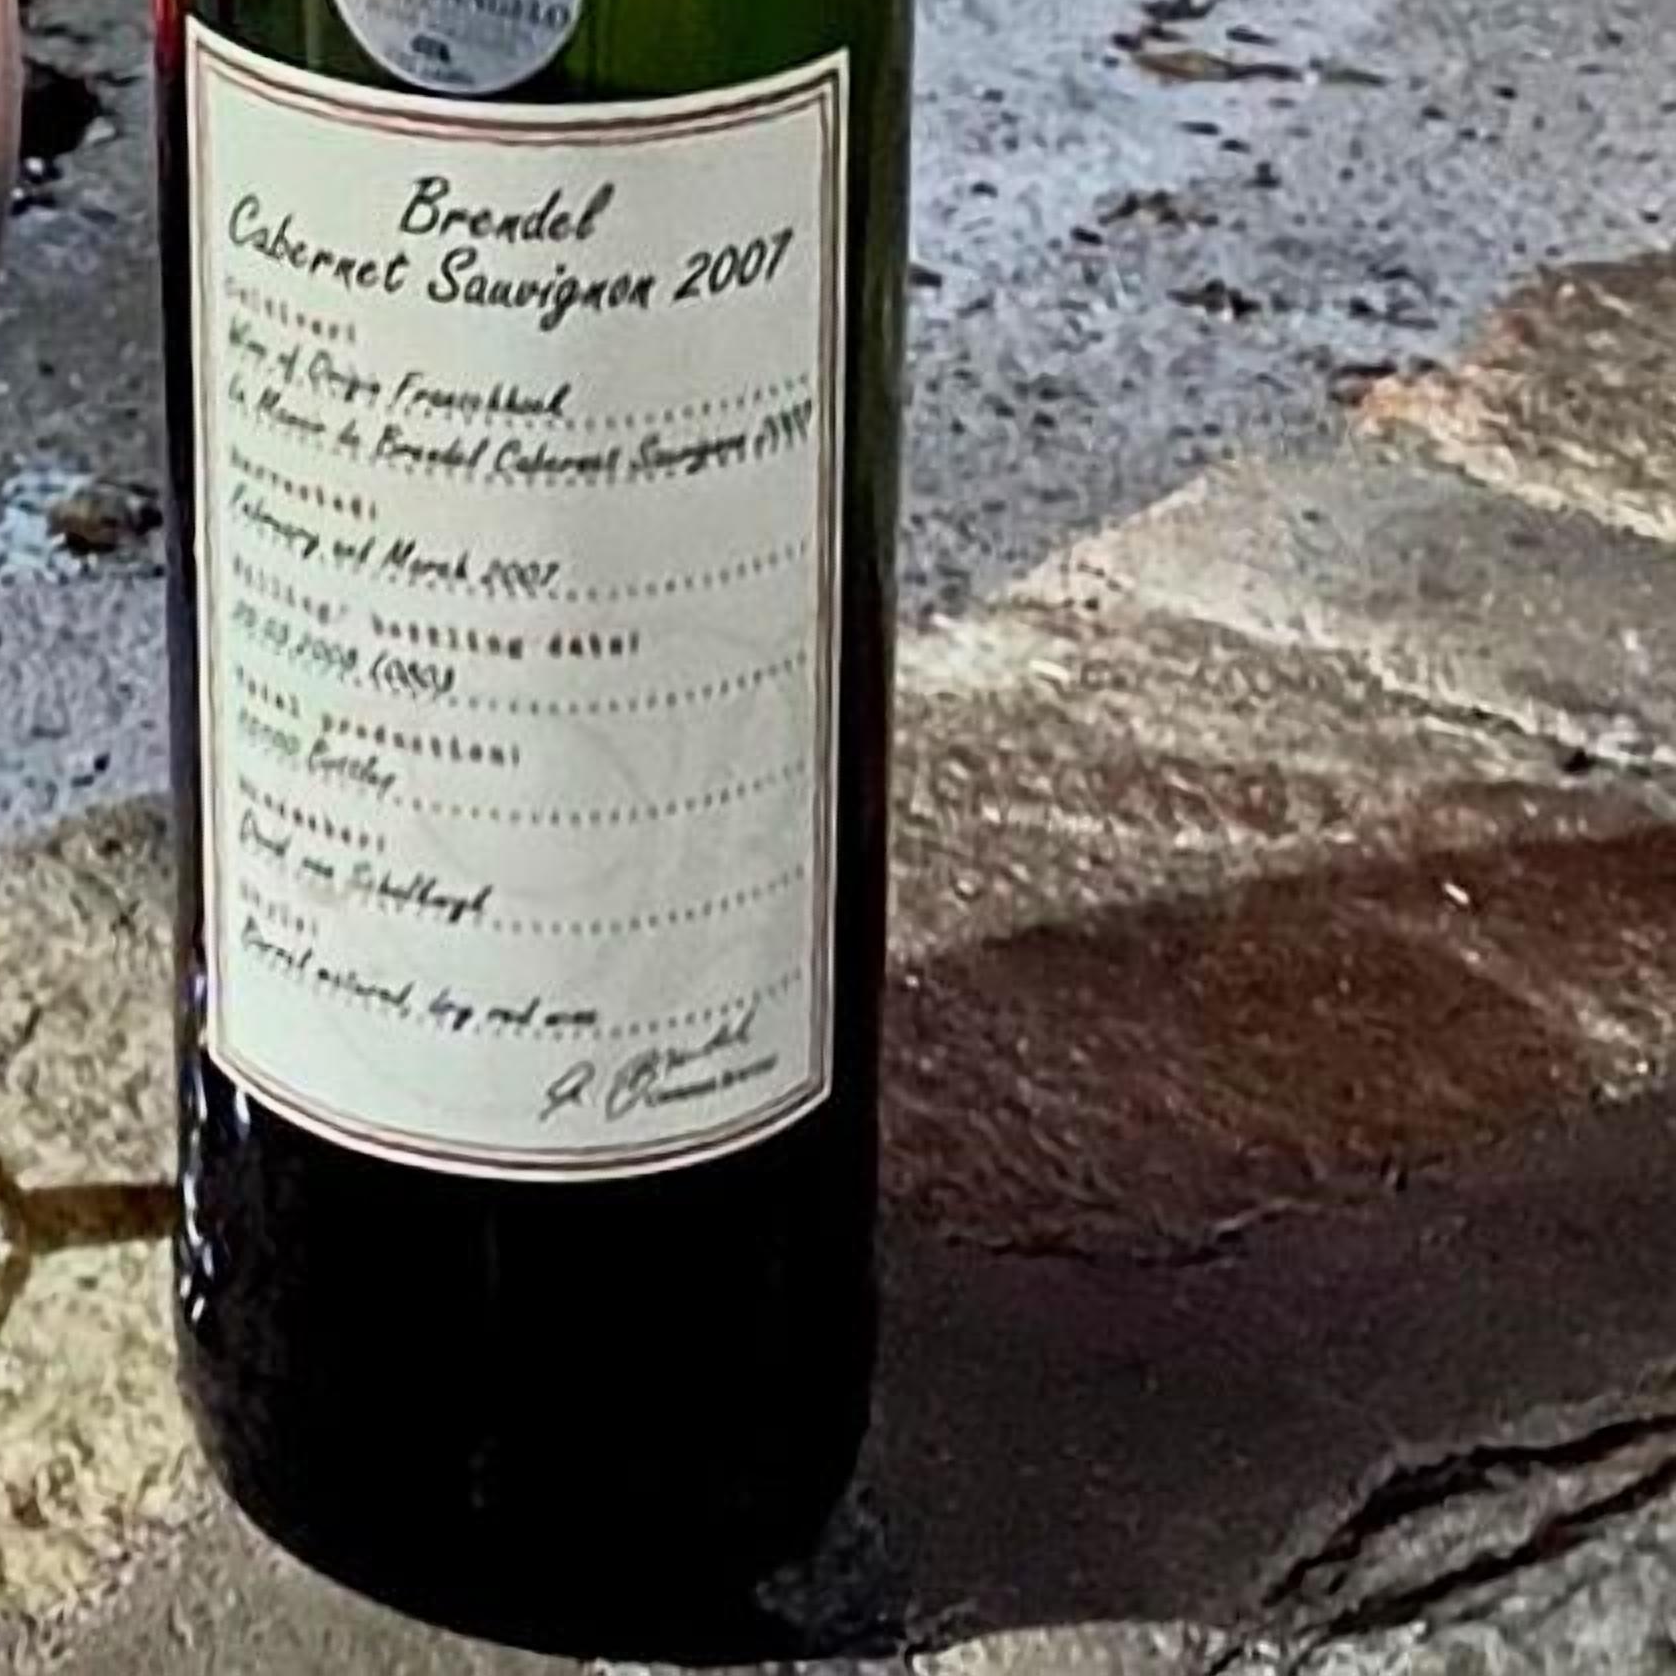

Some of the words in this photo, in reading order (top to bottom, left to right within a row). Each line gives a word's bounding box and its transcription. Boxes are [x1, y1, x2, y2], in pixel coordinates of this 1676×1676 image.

[399, 176, 615, 242] Brendel
[229, 194, 409, 293] Cabernet
[427, 246, 656, 331] Sauvignon
[672, 227, 794, 302] 2007
